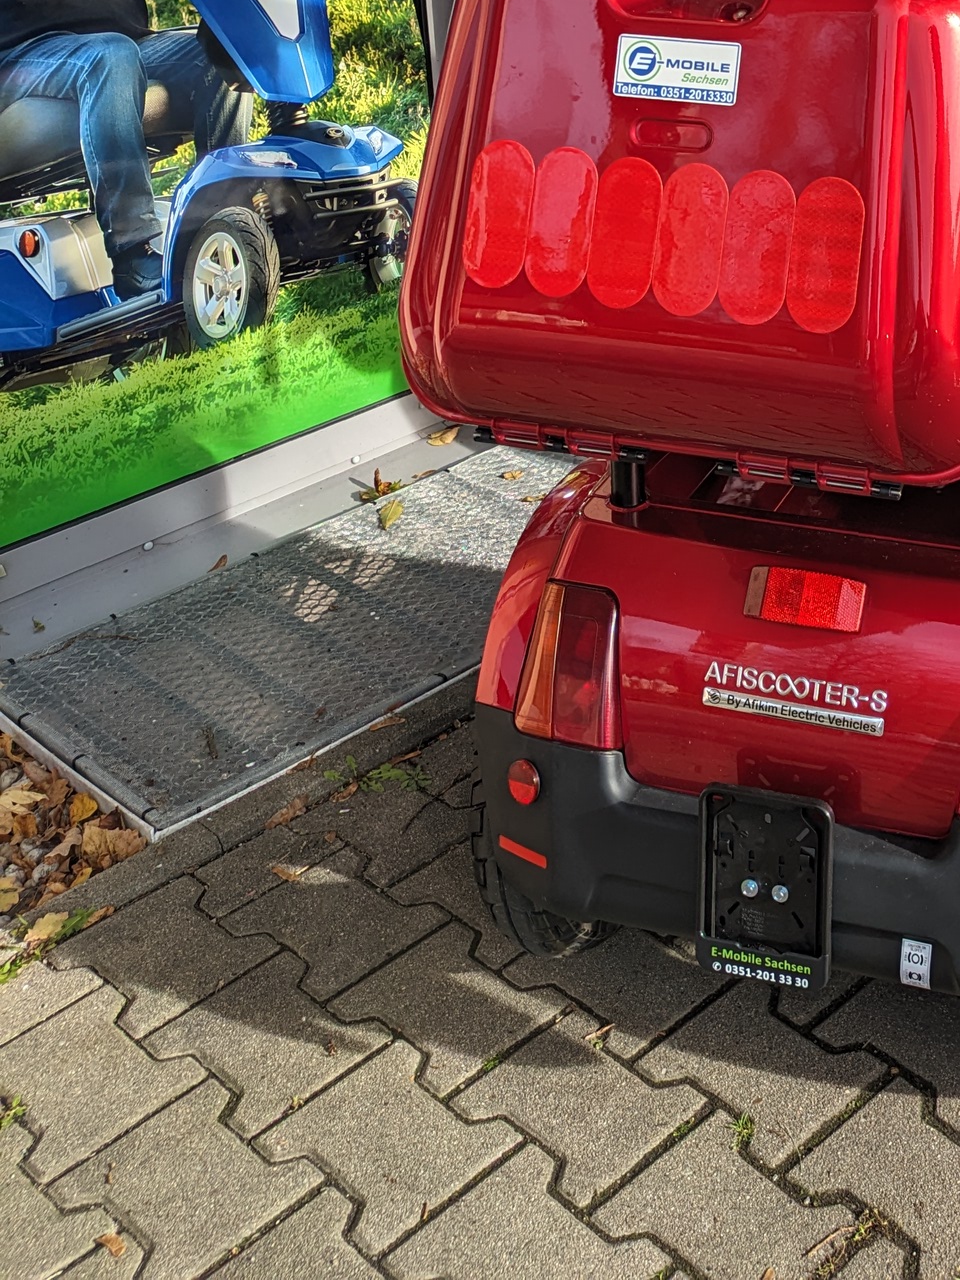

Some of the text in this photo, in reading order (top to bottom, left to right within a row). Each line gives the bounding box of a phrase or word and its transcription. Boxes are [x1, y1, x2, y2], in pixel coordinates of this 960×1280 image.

[616, 83, 734, 103] Telefon: 0351-2013330
[681, 73, 729, 86] Sachsen
[704, 661, 888, 713] AFISCOOTER-S
[727, 694, 877, 733] By Afikim Electric Vehicles
[711, 946, 811, 975] E-Mobile Sachsen
[725, 963, 810, 989] 0351-201 33 30
